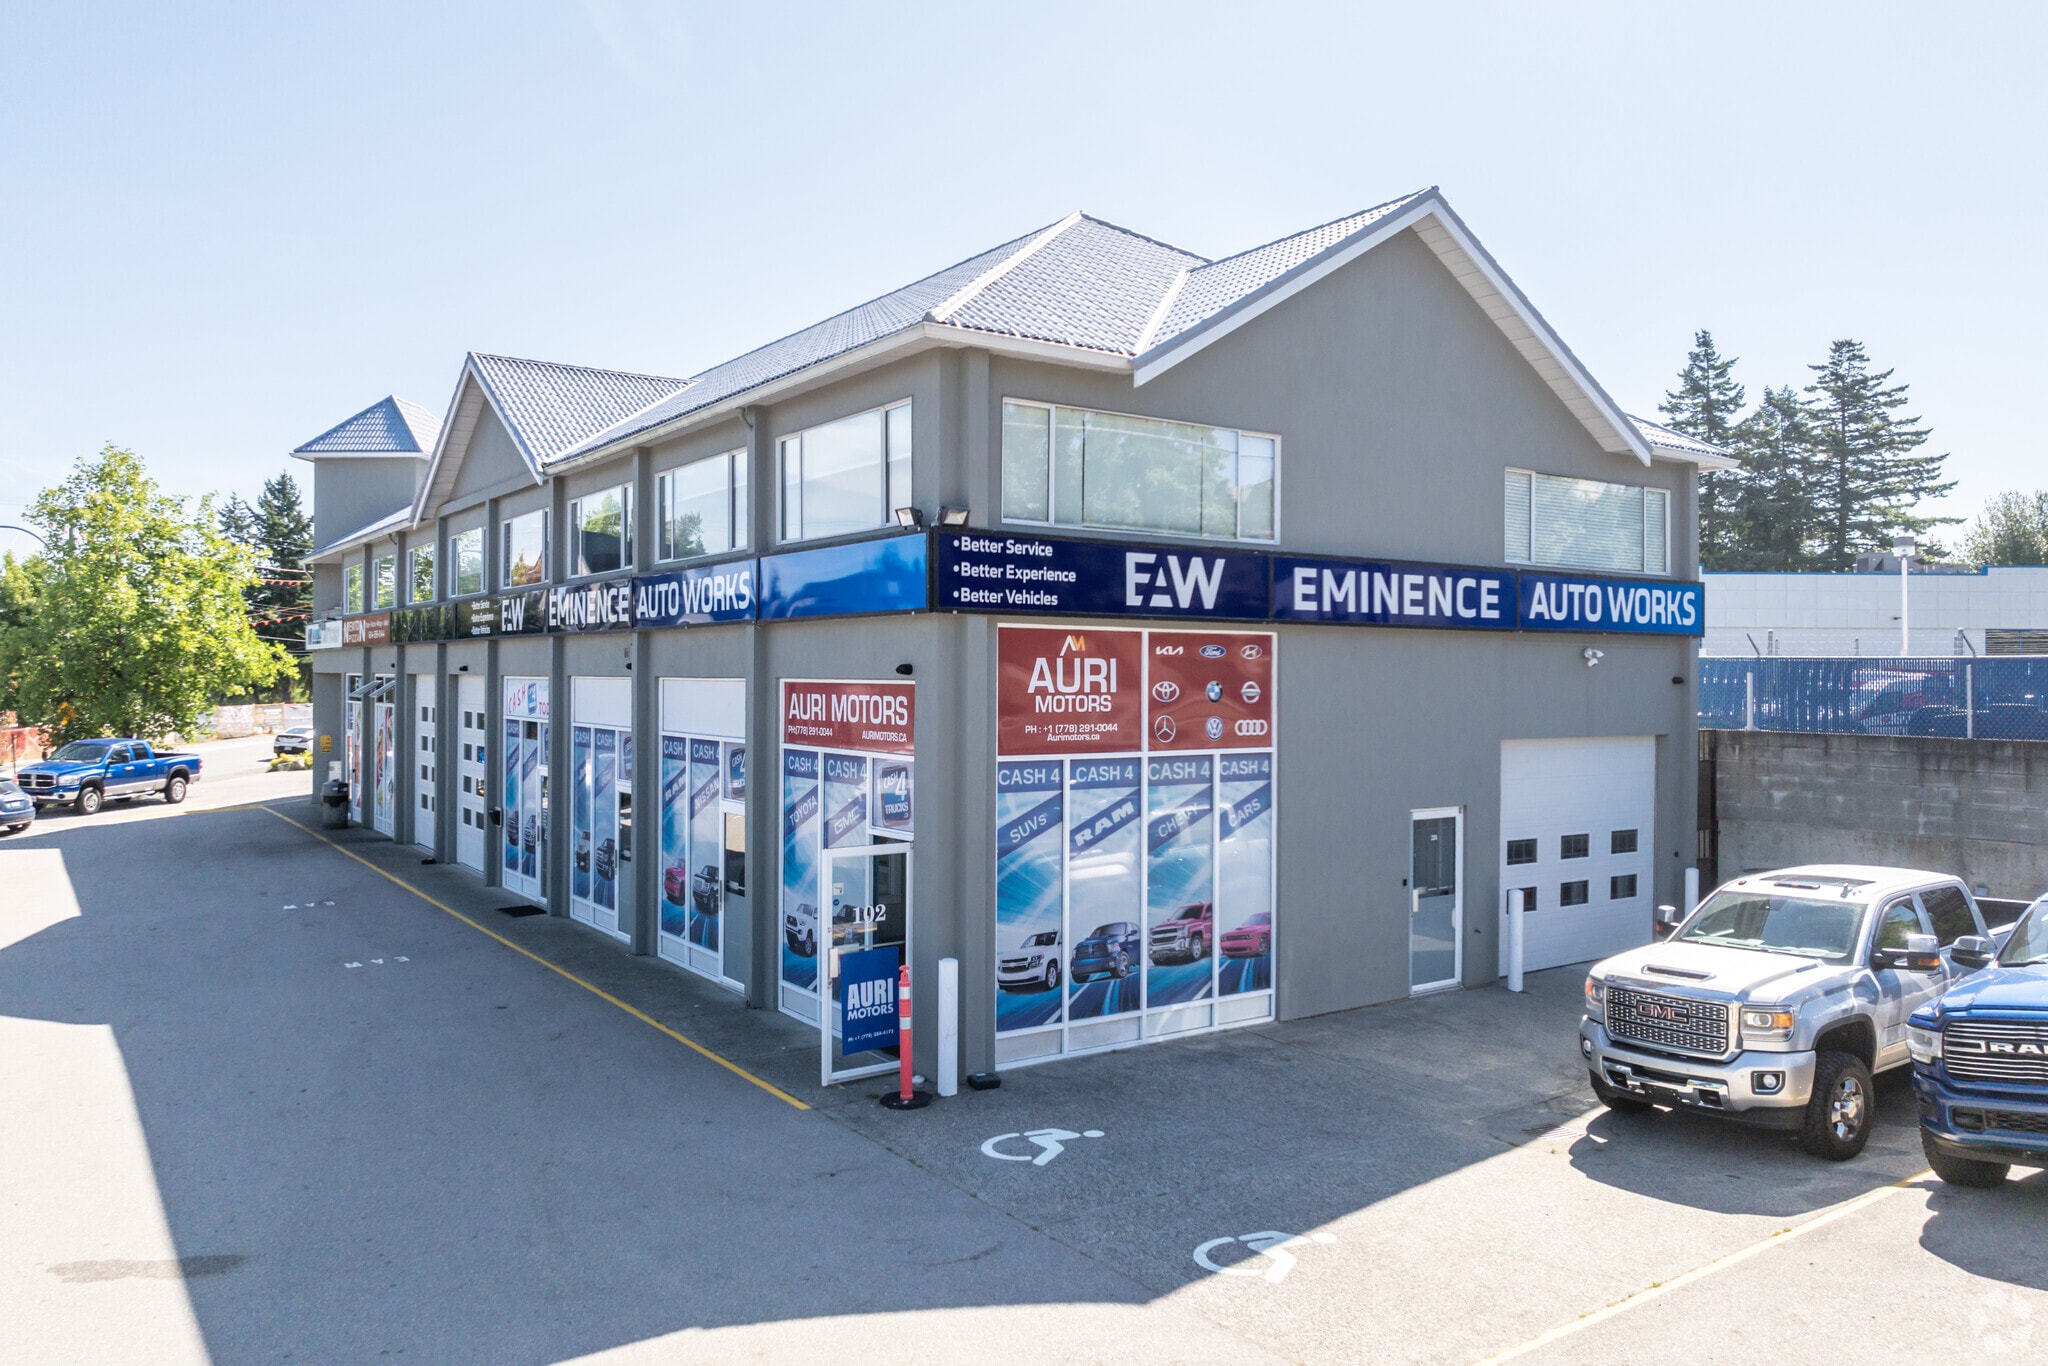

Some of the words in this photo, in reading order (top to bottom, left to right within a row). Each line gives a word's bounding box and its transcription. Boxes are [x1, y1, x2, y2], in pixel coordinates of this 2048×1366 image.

[961, 536, 1003, 554] Better
[1006, 539, 1053, 557] Service
[961, 562, 1003, 579] Better
[1006, 564, 1077, 583] Experience
[549, 587, 630, 627] EMINENCE
[635, 581, 680, 619] AUTO
[681, 571, 751, 615] WORKS
[961, 588, 1003, 603] Better
[1005, 589, 1059, 606] Vehicles
[1293, 566, 1500, 619] EMINENCE
[1528, 581, 1603, 622] AUTO
[1608, 586, 1696, 626] WORKS
[1027, 657, 1118, 694] AURI
[788, 692, 826, 721] AURI
[831, 694, 908, 726] MOTORS
[1035, 695, 1112, 713] MOTORS
[575, 731, 590, 744] CASH
[1043, 724, 1053, 733] +1
[1055, 723, 1078, 734] (778)
[1079, 723, 1118, 732] 291-0044
[1047, 733, 1100, 742] Aurimotors.ca
[597, 734, 613, 747] CASH
[663, 740, 683, 756] CASH
[693, 744, 715, 760] CASH
[788, 755, 811, 771] CASH
[827, 760, 858, 779] CASH
[860, 763, 867, 779] 4
[1149, 762, 1197, 781] CASH
[1200, 761, 1210, 778] 4
[1219, 760, 1258, 776] CASH
[1261, 760, 1270, 773] 4
[999, 768, 1048, 785] CASH
[1050, 767, 1060, 783] 4
[1076, 765, 1121, 782] CASH
[1124, 765, 1134, 780] 4
[895, 771, 907, 801] 4
[789, 795, 818, 827] TOYOTA
[834, 805, 862, 835] GMC
[1228, 798, 1261, 828] CARS
[1009, 812, 1047, 844] SUVs
[1074, 800, 1135, 847] RAM
[853, 904, 887, 924] 102
[847, 978, 894, 1011] AURI
[847, 1003, 894, 1021] MOTORS
[1637, 1002, 1687, 1023] GMC
